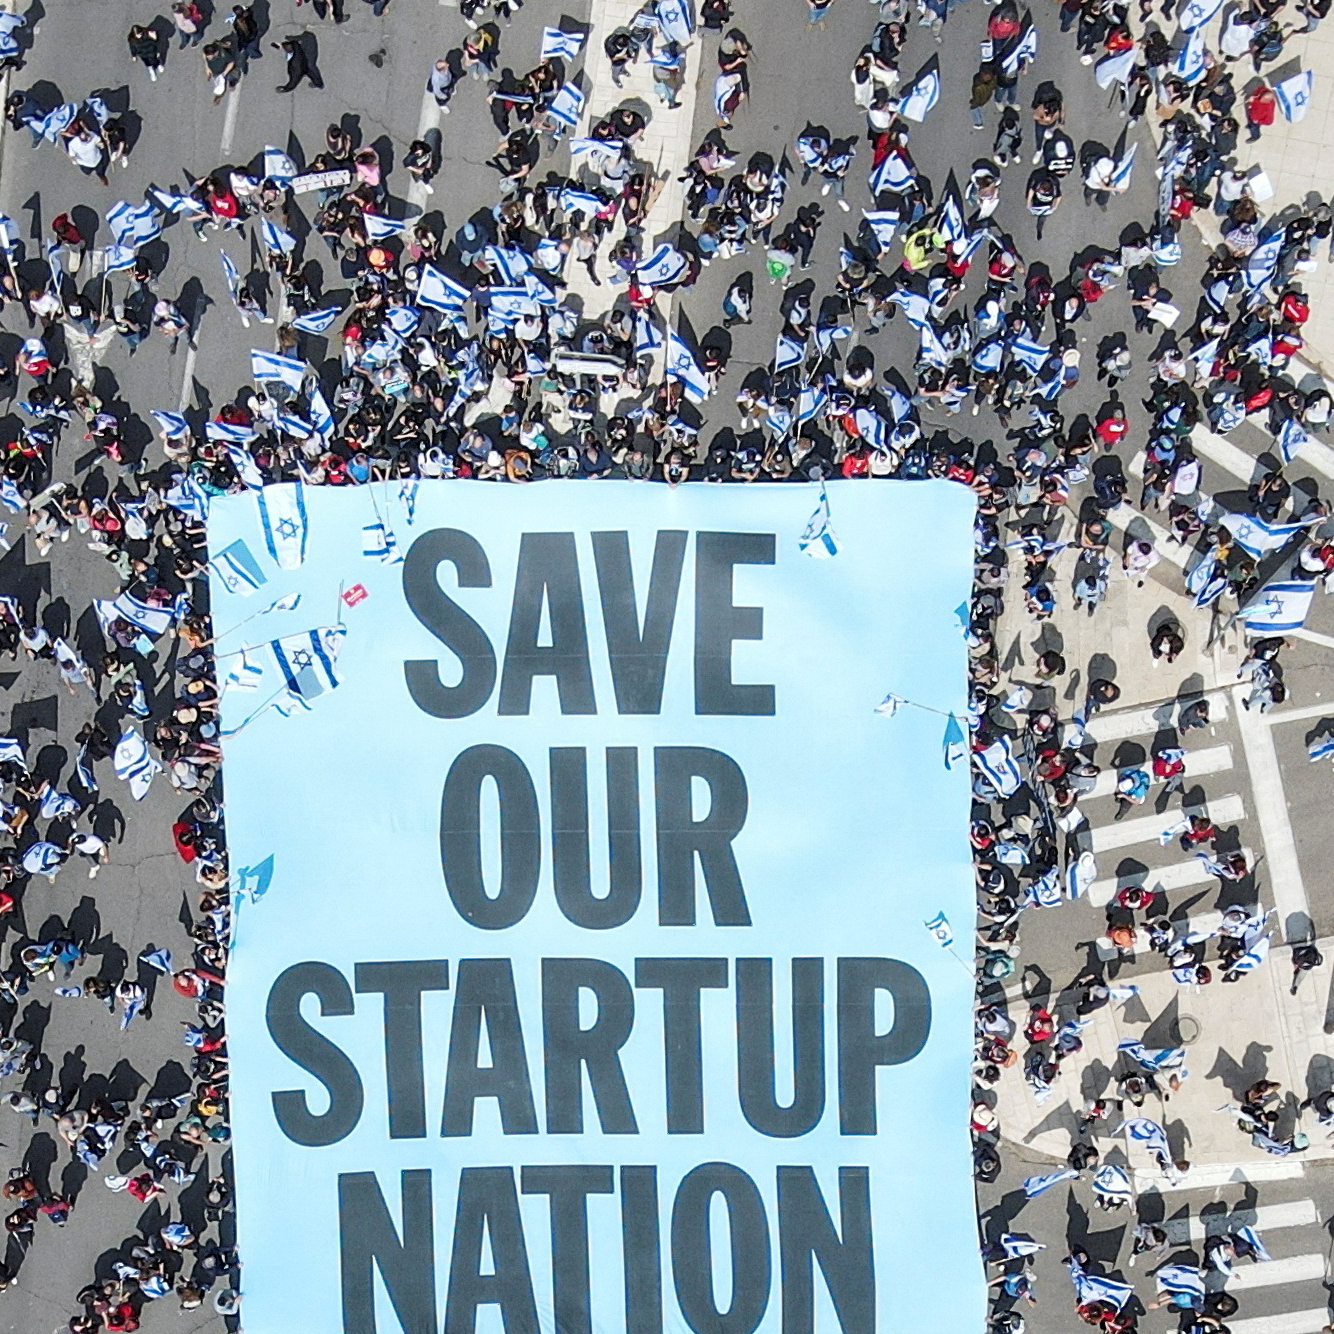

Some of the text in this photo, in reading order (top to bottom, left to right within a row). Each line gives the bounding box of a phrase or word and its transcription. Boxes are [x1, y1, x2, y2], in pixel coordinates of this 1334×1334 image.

[403, 528, 776, 719] SAVE
[440, 744, 752, 930] OUR
[266, 957, 931, 1147] STARTUP
